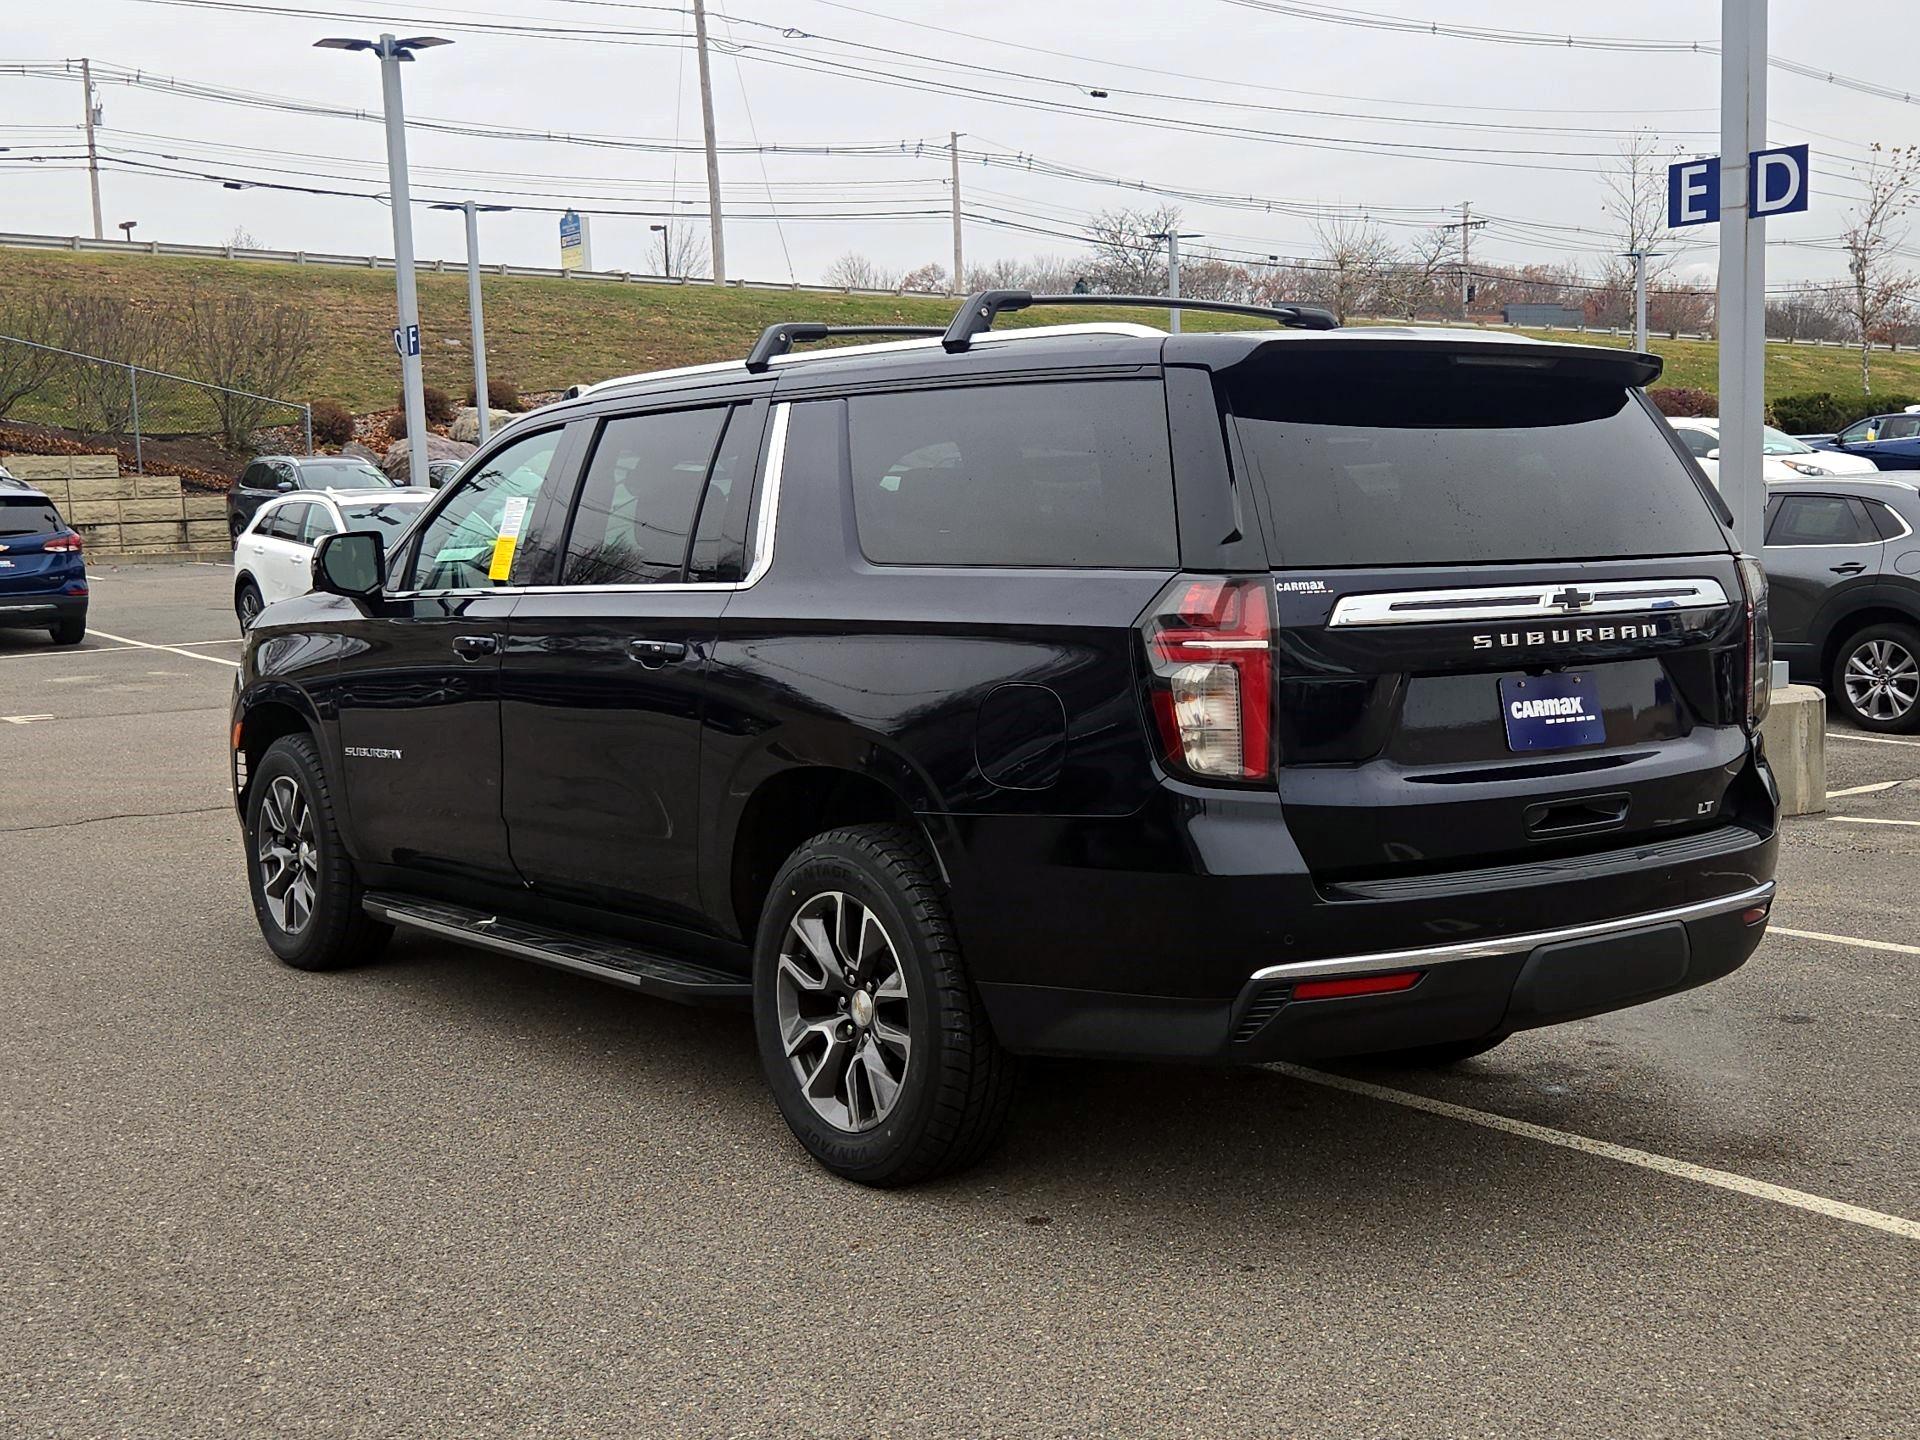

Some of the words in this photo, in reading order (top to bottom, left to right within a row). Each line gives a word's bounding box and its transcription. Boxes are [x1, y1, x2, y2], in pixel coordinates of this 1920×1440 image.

[1680, 163, 1708, 223] E
[1756, 153, 1801, 213] D
[409, 326, 417, 354] F
[1472, 623, 1658, 650] SUBURBAN
[344, 747, 402, 760] SUBURBAN
[1697, 800, 1715, 815] LT
